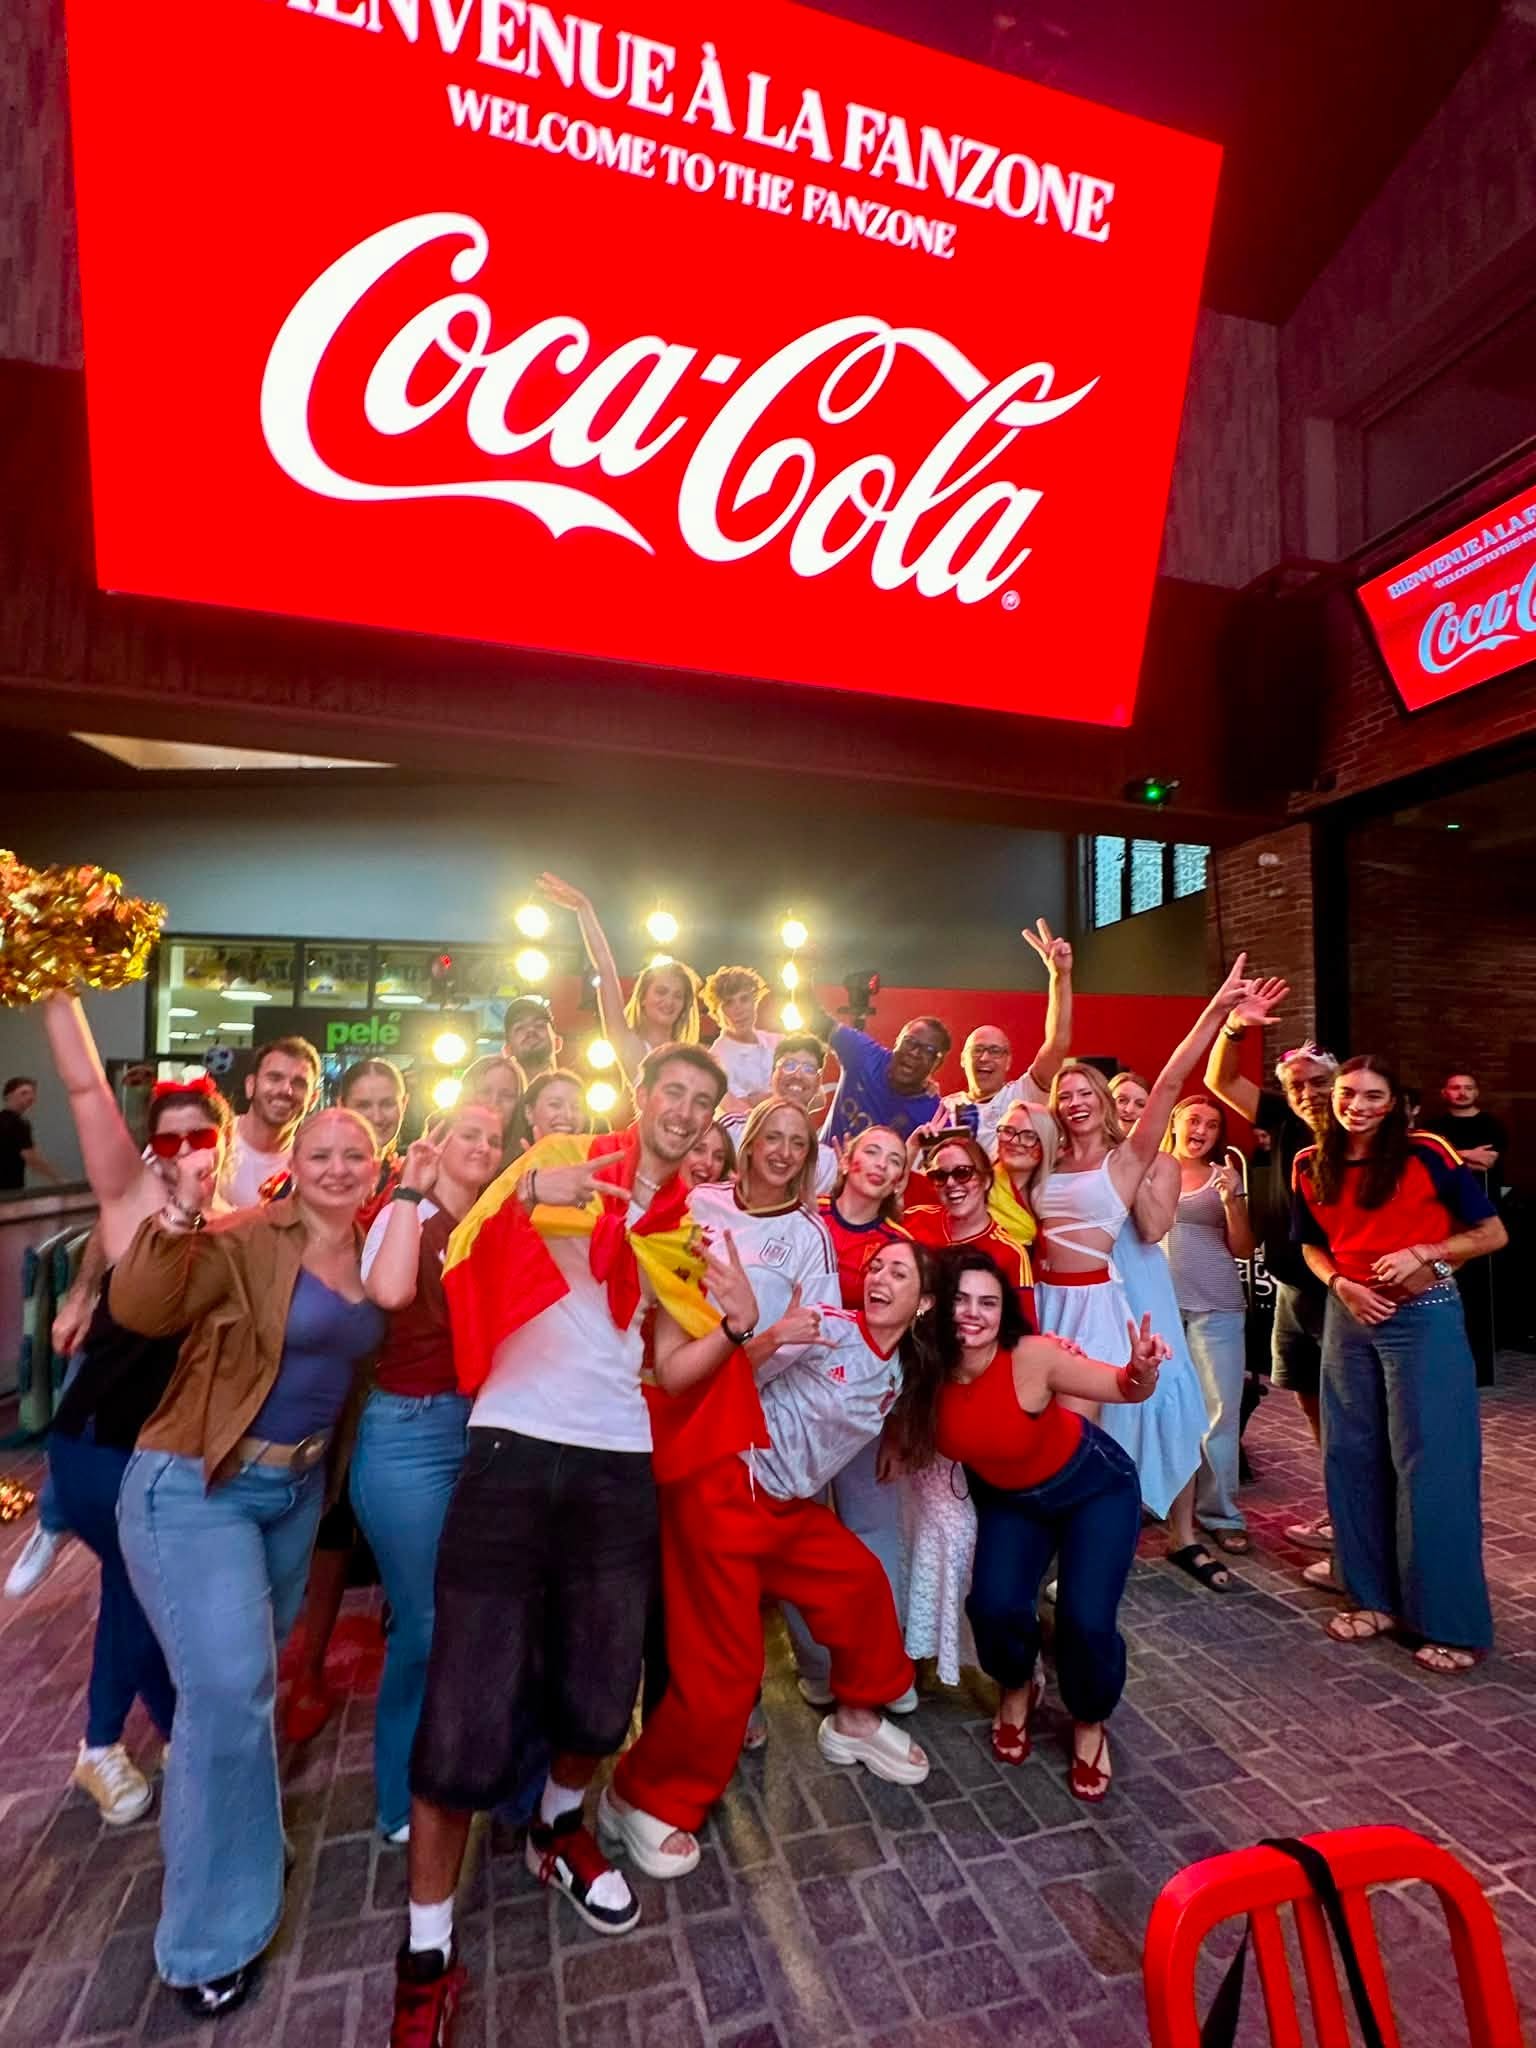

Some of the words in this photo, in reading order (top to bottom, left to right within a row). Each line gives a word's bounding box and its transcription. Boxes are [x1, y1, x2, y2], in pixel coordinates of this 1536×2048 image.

[288, 0, 675, 115] NVENUE
[683, 43, 734, 133] À
[744, 72, 832, 162] LA
[841, 103, 1114, 242] FANZONE
[447, 85, 656, 177] WELCOME
[661, 145, 715, 192] TO
[719, 161, 793, 214] THE
[802, 185, 956, 258] FANZONE
[261, 212, 1099, 603] Coca-Cola
[1388, 538, 1483, 599] BIENVENUE
